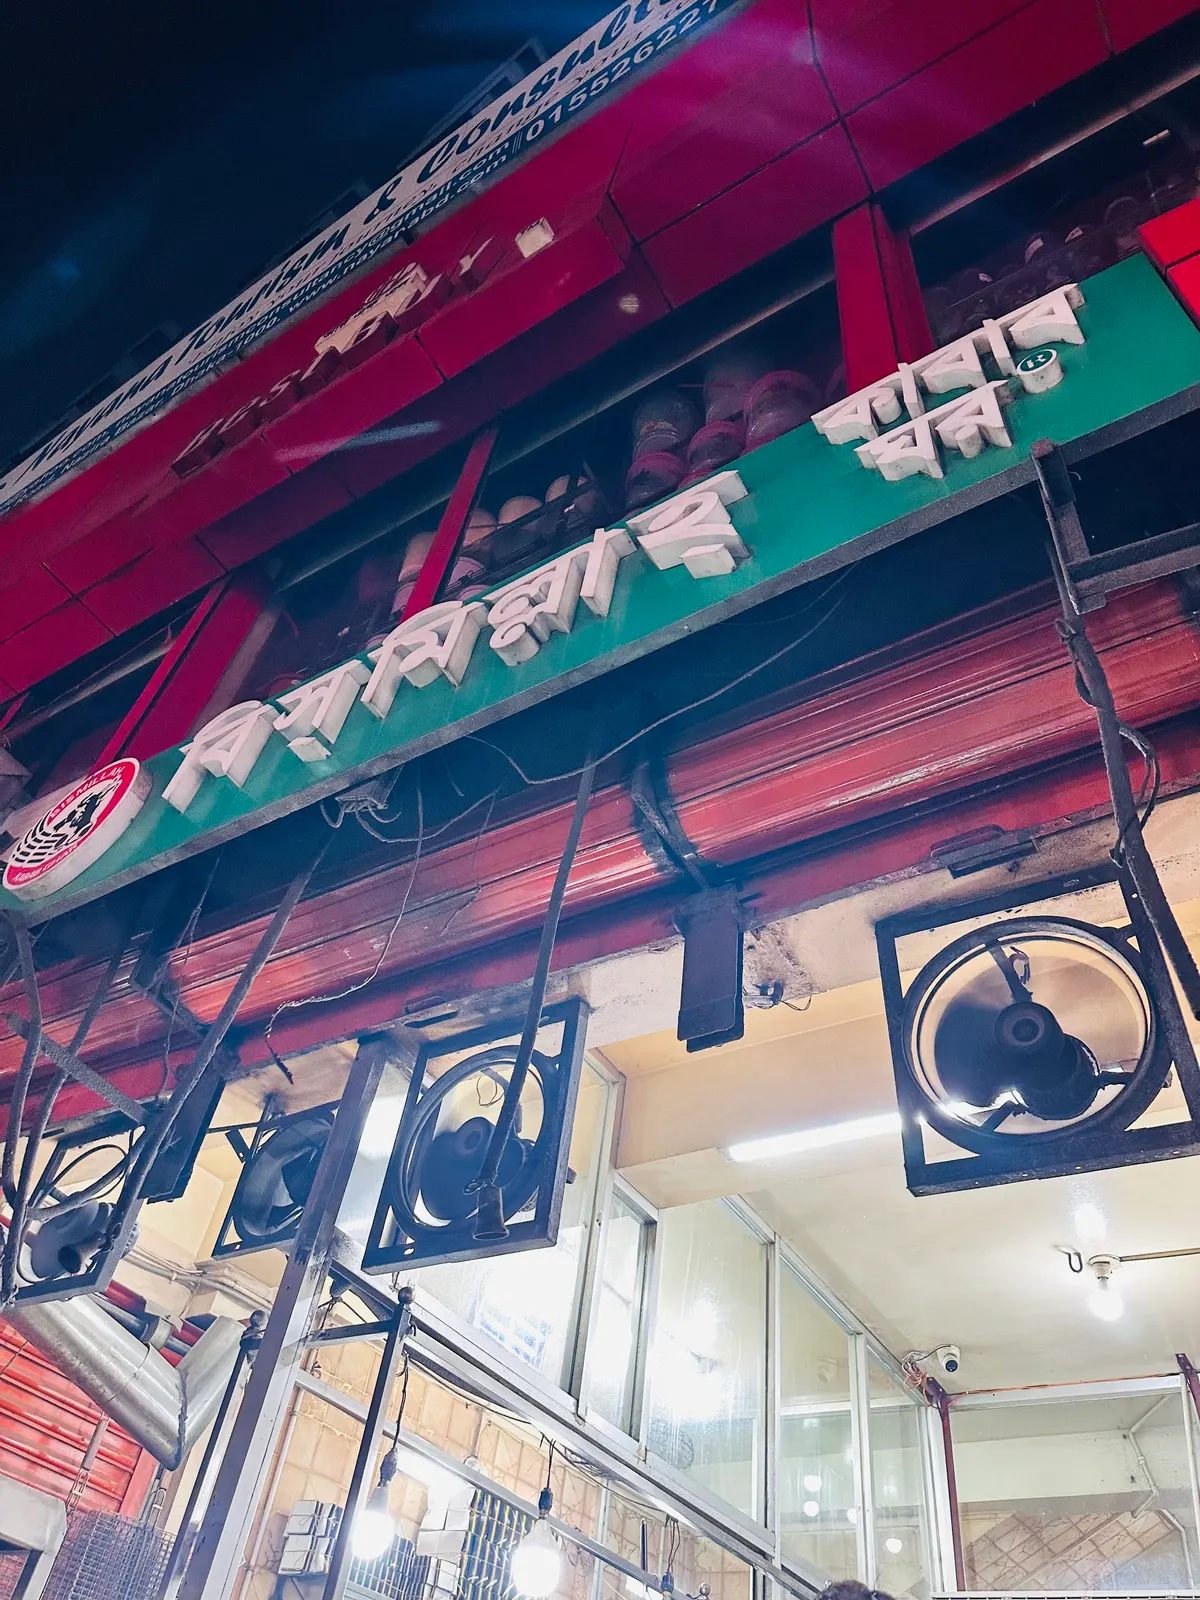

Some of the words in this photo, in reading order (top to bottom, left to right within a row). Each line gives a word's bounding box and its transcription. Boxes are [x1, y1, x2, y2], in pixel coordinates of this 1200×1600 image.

[452, 89, 559, 173] change
[564, 24, 650, 95] your
[13, 355, 173, 486] Nayana
[175, 223, 350, 365] Tourism
[363, 176, 403, 223] &
[417, 0, 671, 185] Consult
[289, 152, 506, 312] www.nayanabd.com
[811, 283, 1082, 440] কাবাব
[854, 380, 1012, 478] ঘর
[51, 765, 125, 818] BISMILLAH
